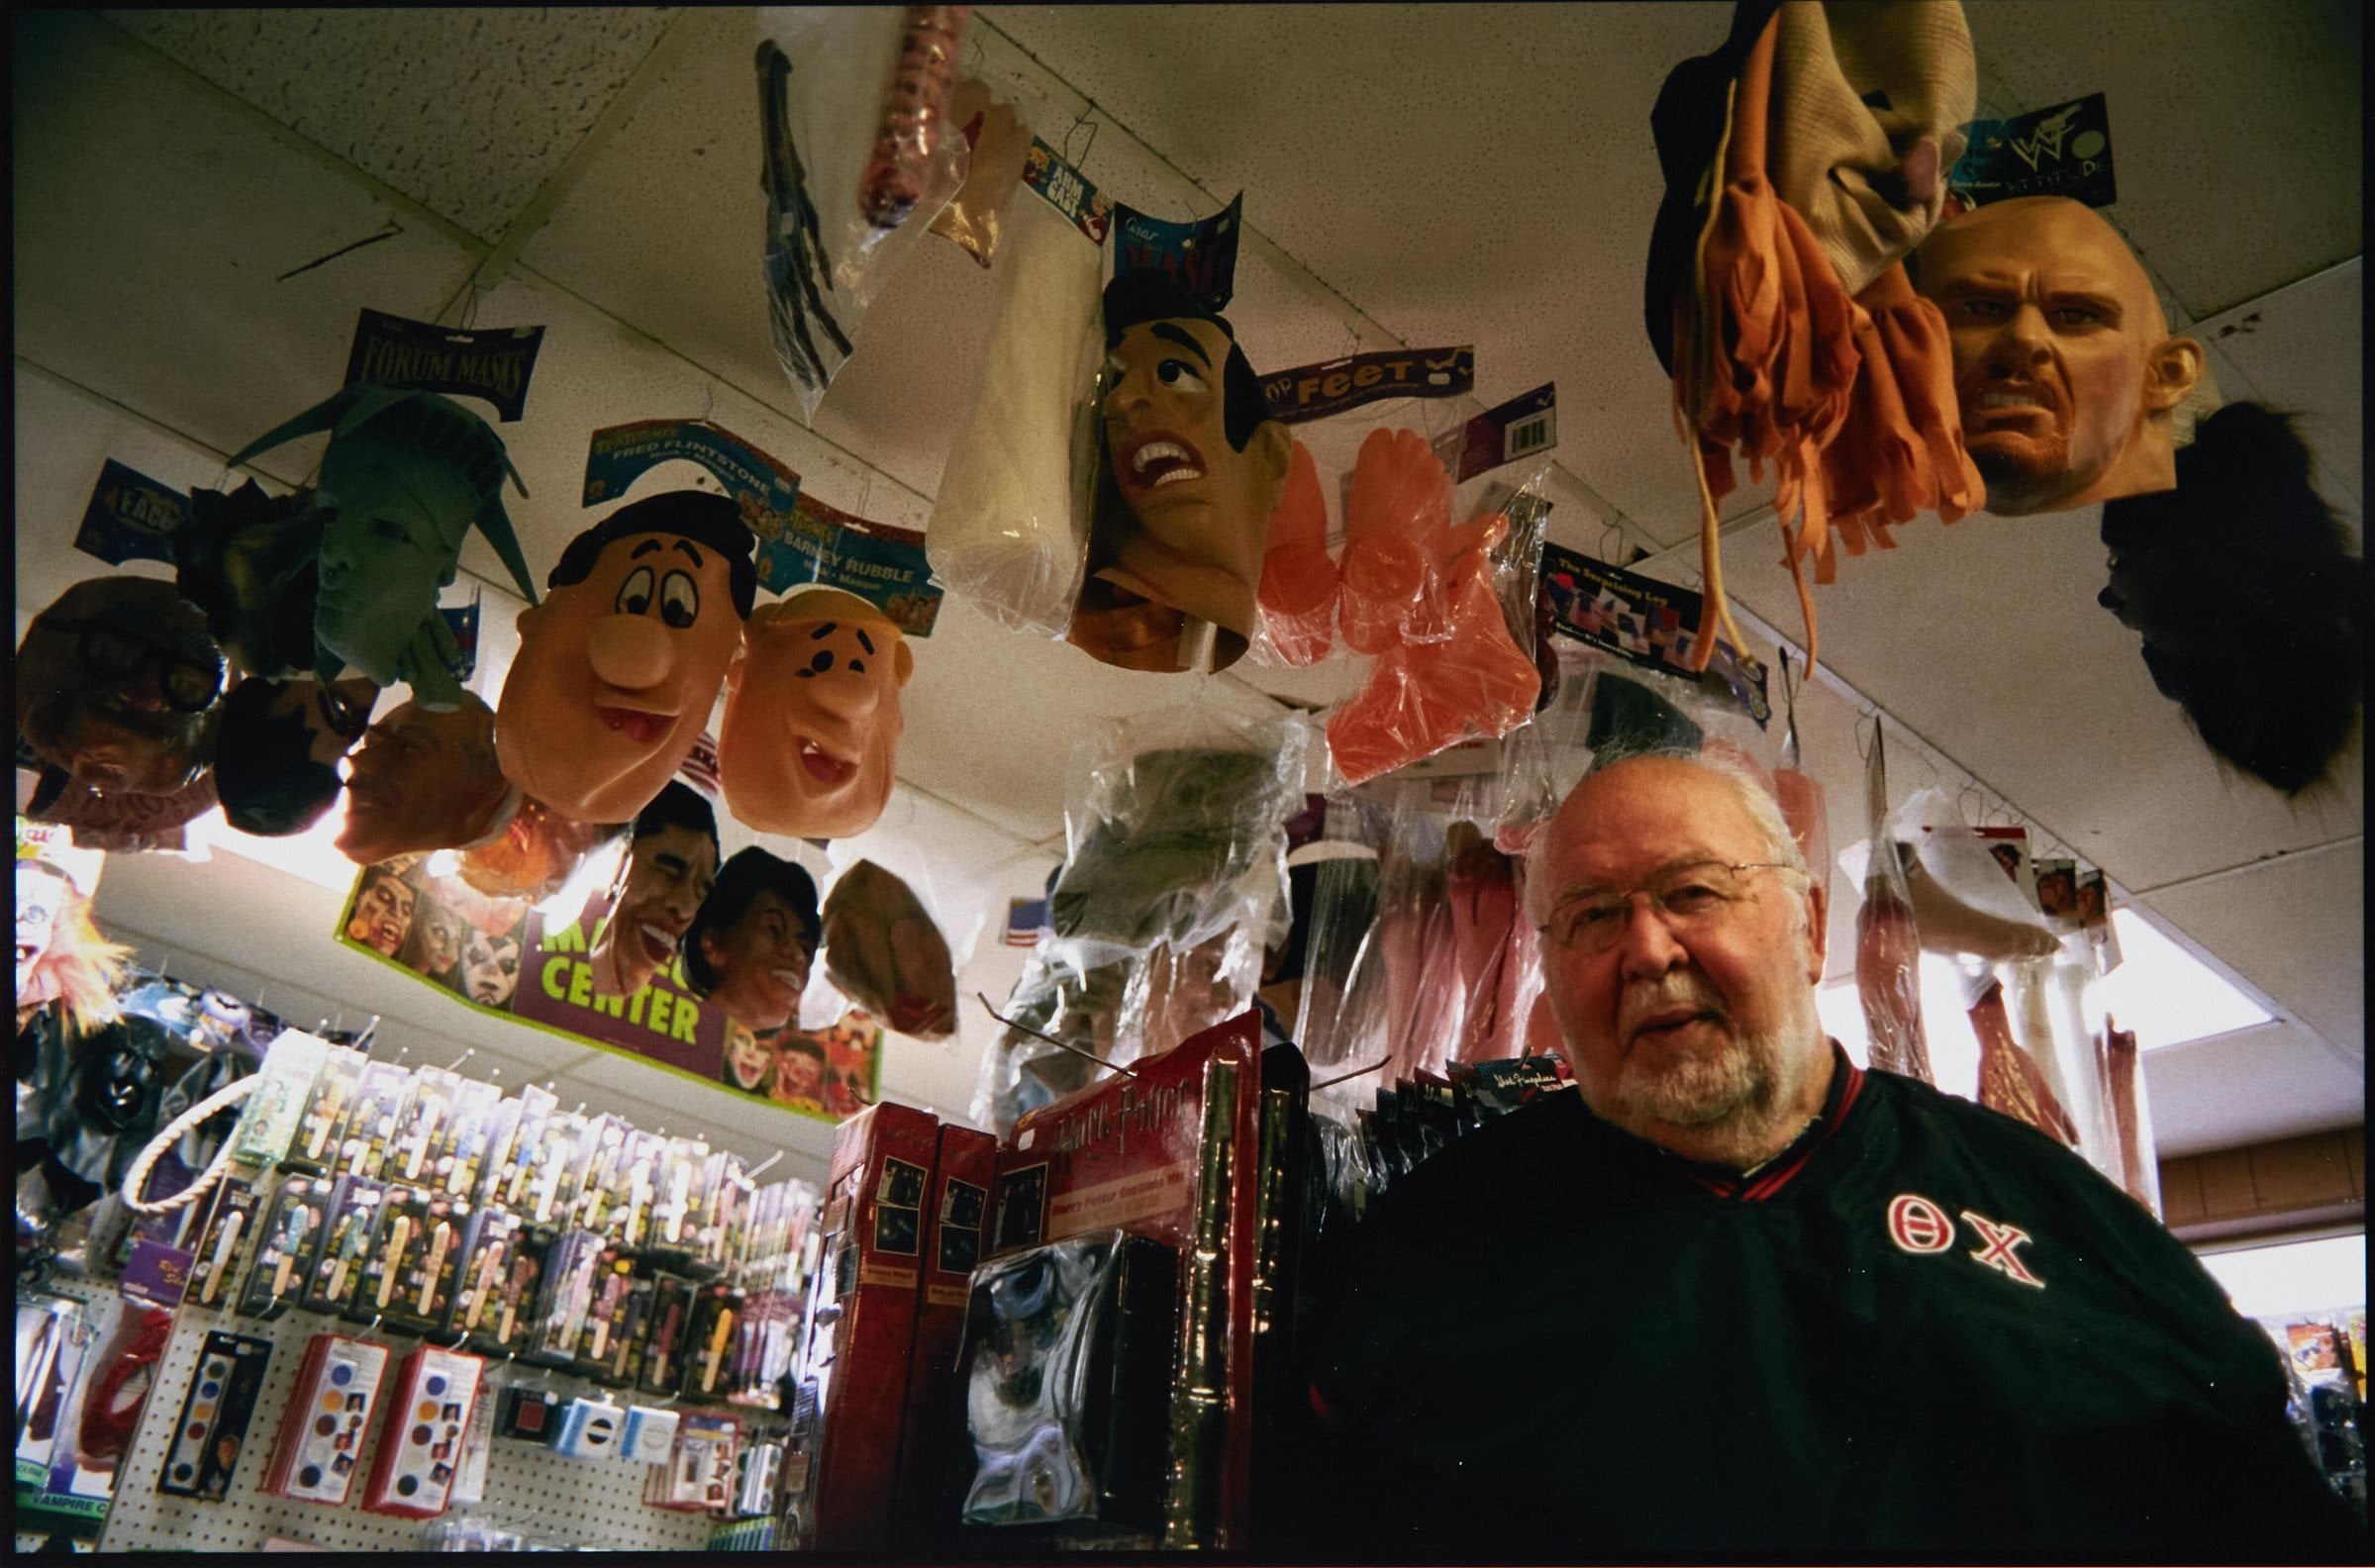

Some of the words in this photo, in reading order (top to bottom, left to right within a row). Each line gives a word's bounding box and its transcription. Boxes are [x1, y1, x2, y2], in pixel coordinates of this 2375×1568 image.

[1047, 180, 1080, 218] CAST
[1052, 165, 1084, 201] ARM
[360, 333, 452, 383] FORUM
[457, 344, 523, 398] MASKS
[612, 441, 660, 460] FRED
[663, 440, 772, 496] FLINTSTONE
[783, 530, 842, 568] BARNEY
[844, 557, 915, 584] RUBBLE
[1557, 556, 1581, 574] The
[542, 955, 701, 1046] CENTER
[33, 1494, 95, 1512] VAMPIRE
